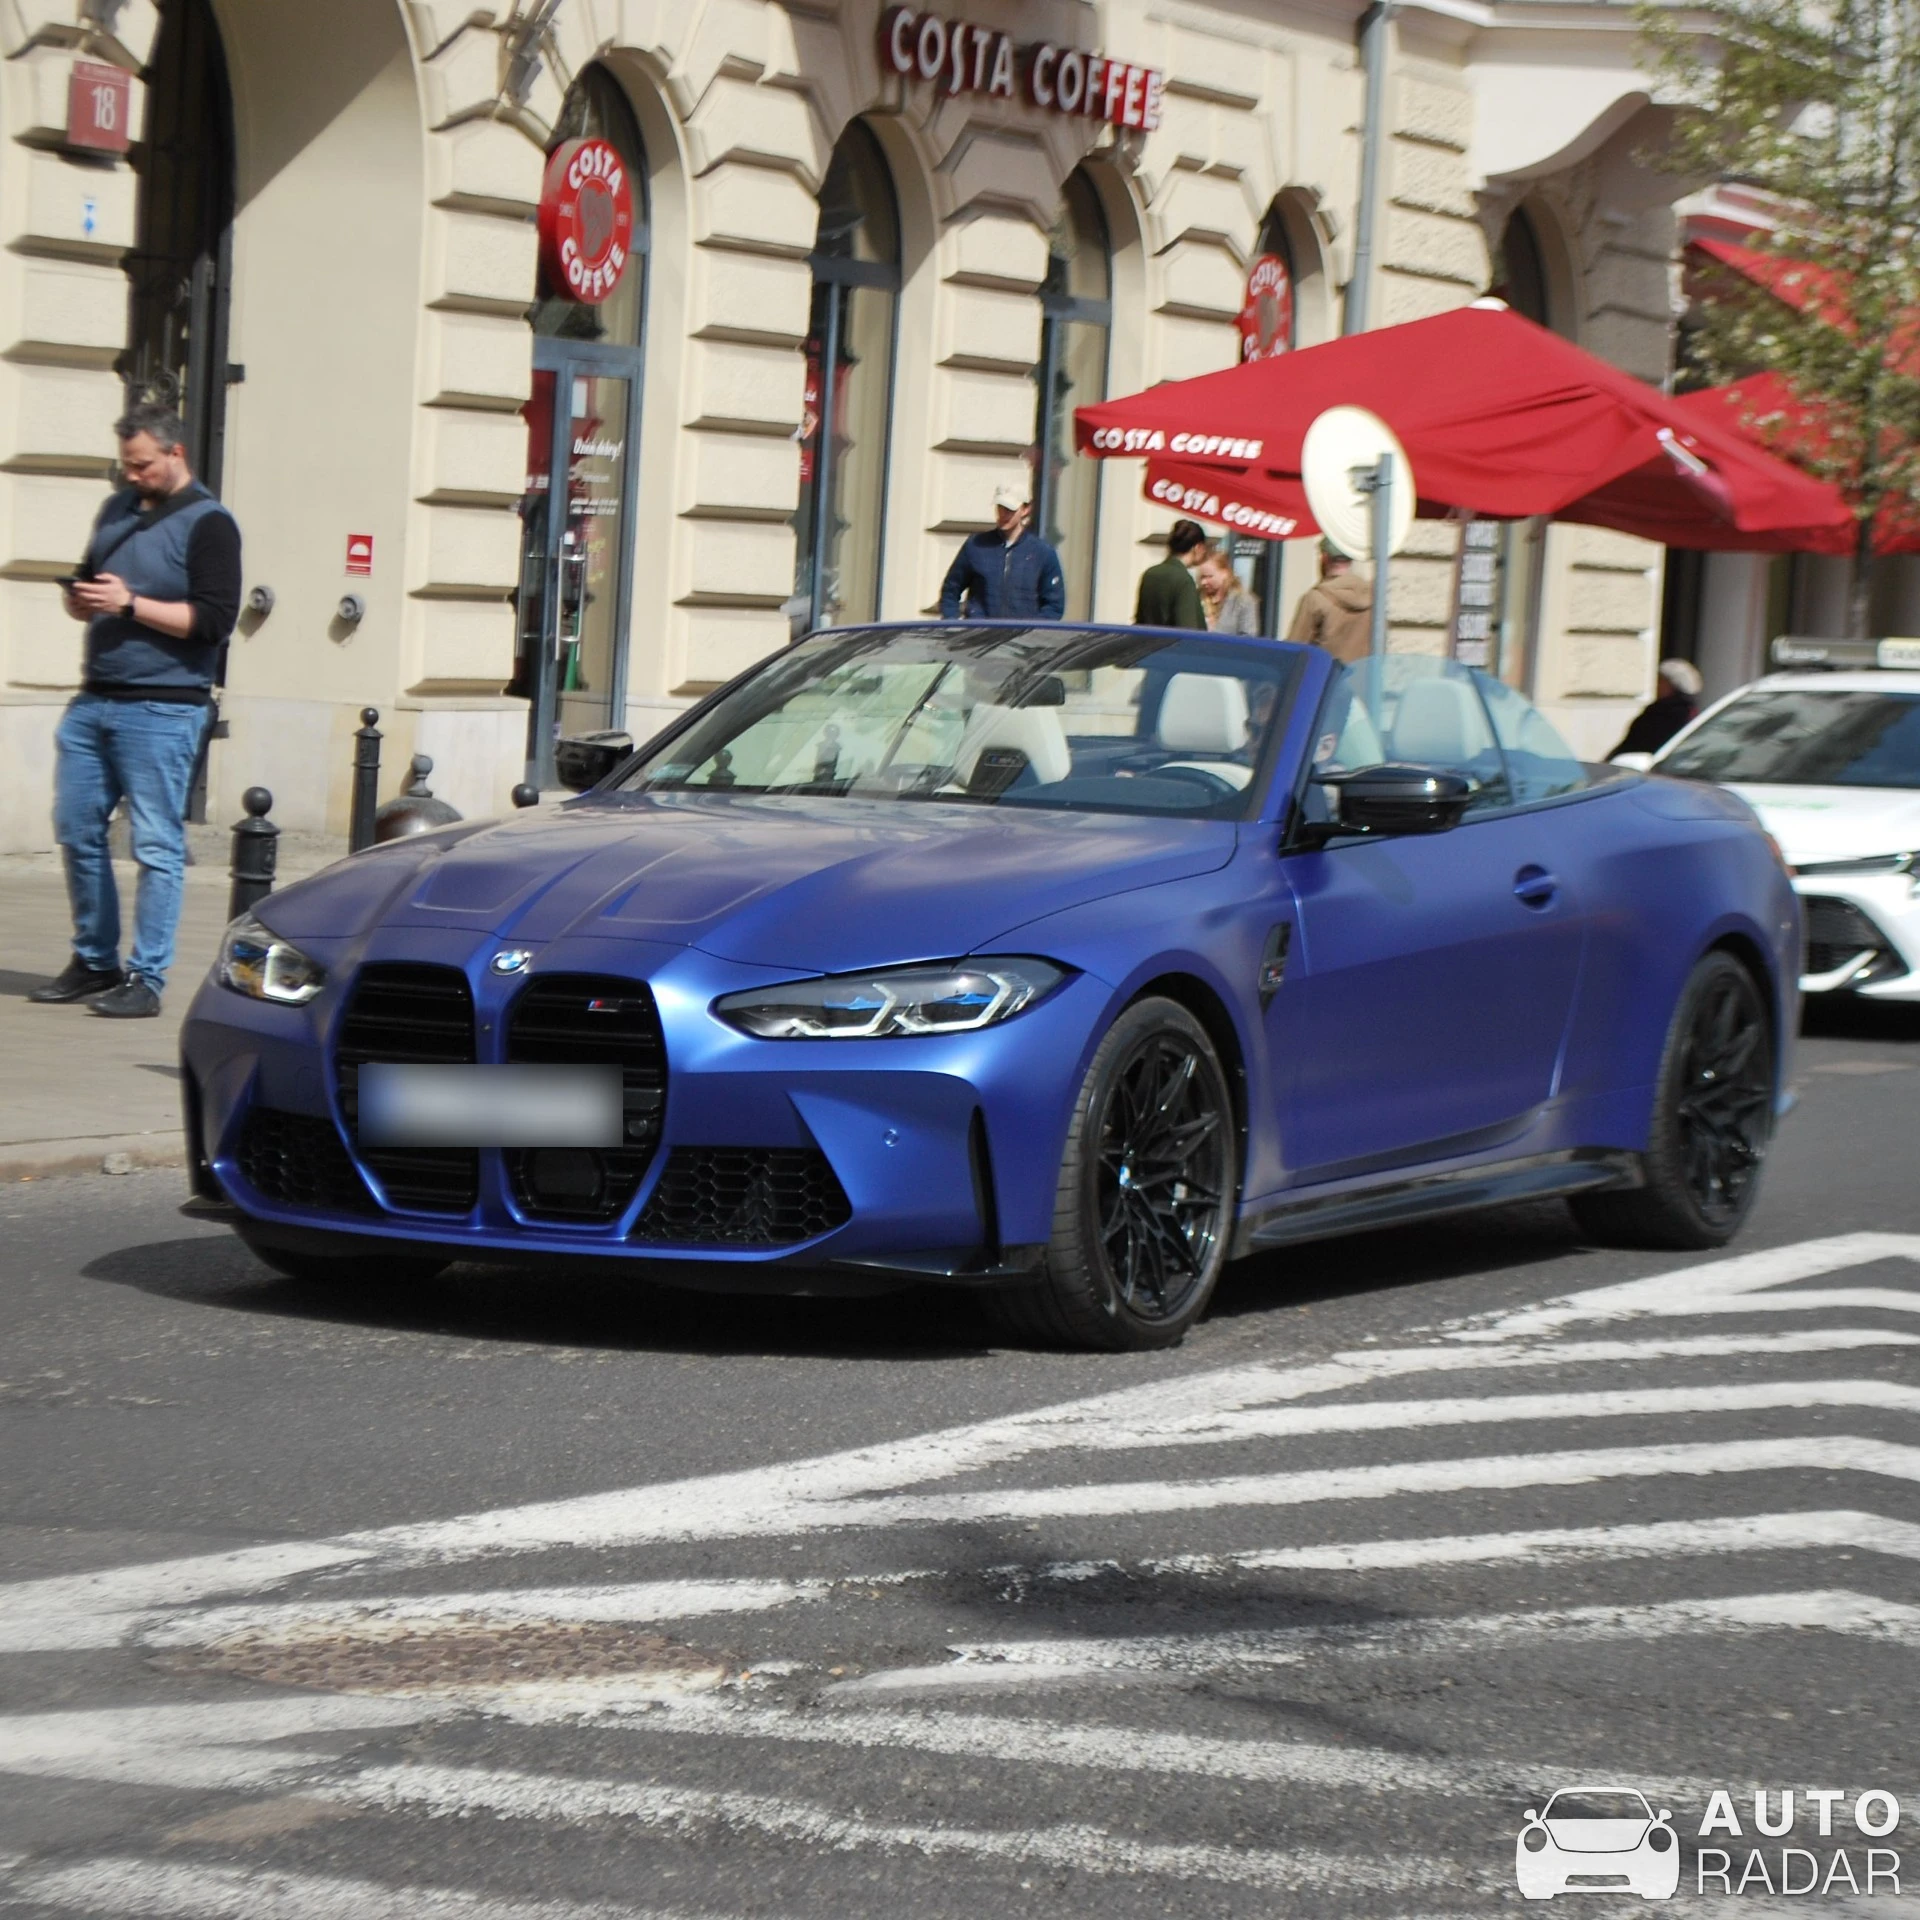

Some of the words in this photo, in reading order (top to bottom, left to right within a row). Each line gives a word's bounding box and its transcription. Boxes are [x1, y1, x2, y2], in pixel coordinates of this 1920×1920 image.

[891, 8, 1013, 96] COSTA
[1033, 44, 1162, 129] COFFEE
[91, 85, 116, 130] 18
[569, 144, 622, 198] COSTA
[561, 236, 625, 297] COFFEE
[1093, 427, 1165, 451] COSTA
[1170, 433, 1263, 459] COFFEE
[1152, 478, 1219, 516] COSTA
[1222, 502, 1297, 535] COFFEE
